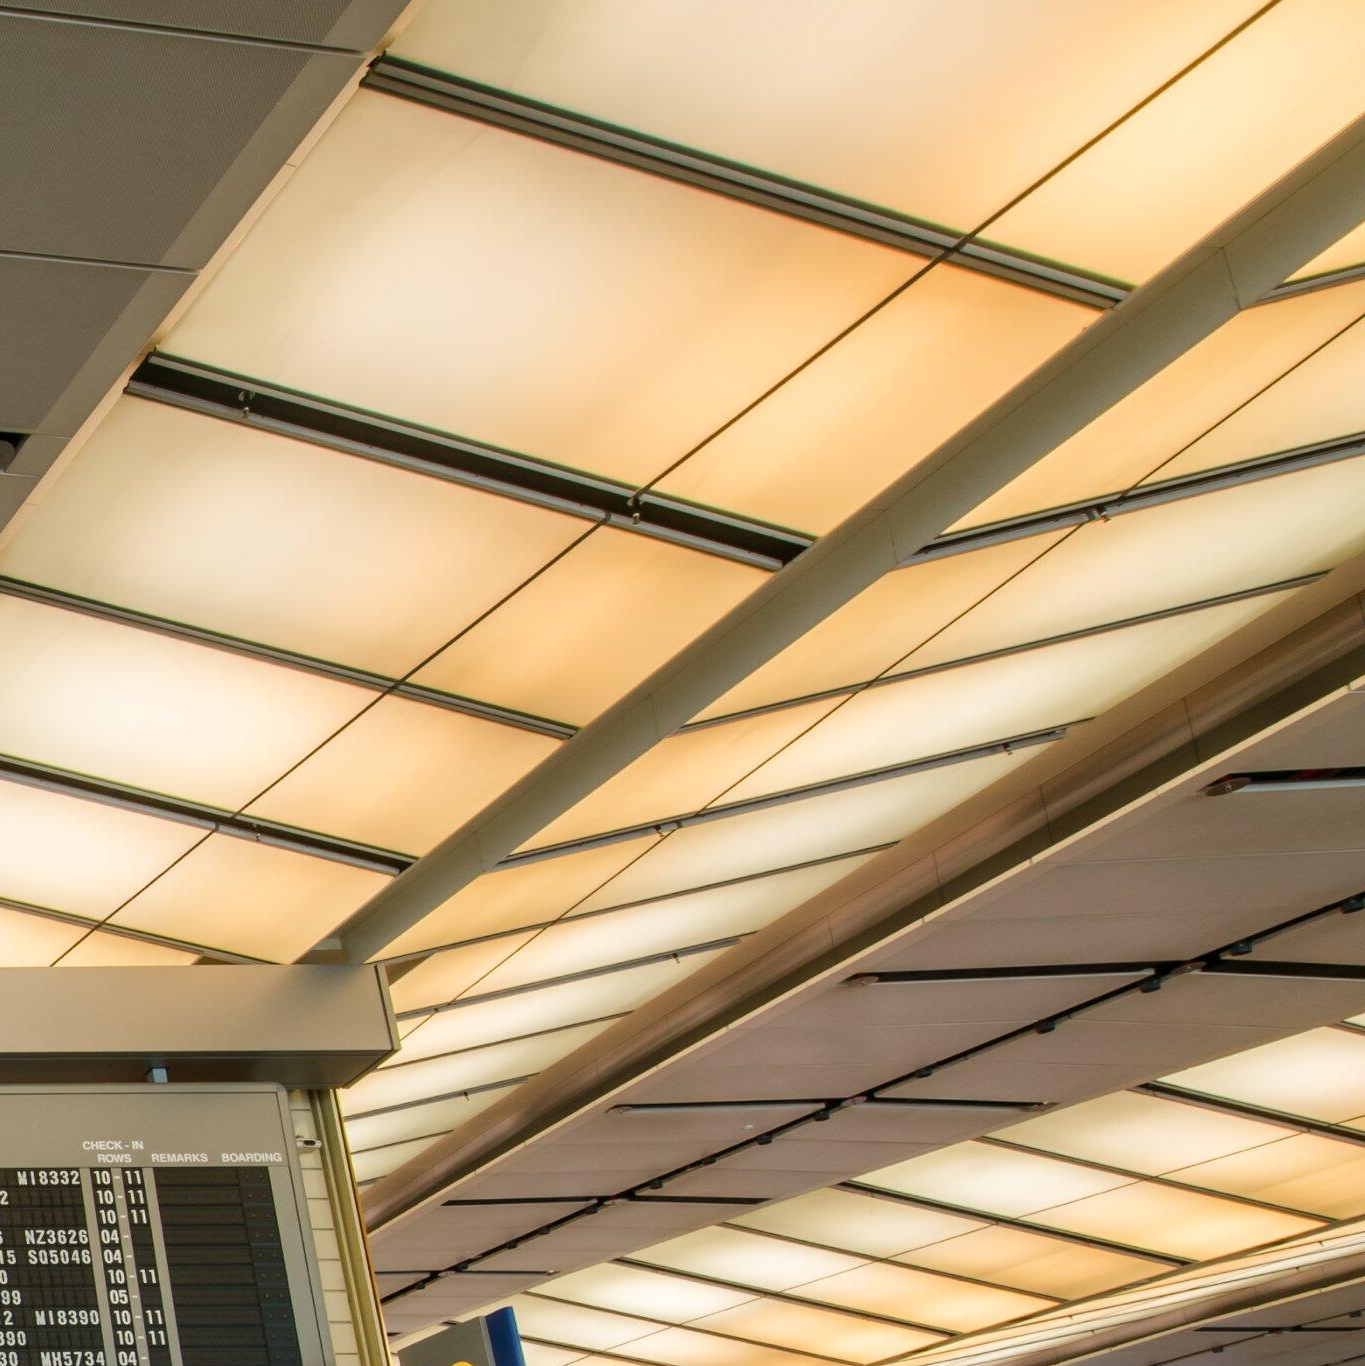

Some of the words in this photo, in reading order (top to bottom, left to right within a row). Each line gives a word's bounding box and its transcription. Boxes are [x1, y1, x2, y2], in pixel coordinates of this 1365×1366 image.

[83, 1141, 120, 1149] CHECK
[133, 1141, 143, 1149] IN
[98, 1154, 132, 1162] ROWS
[152, 1153, 208, 1162] REMARKS
[222, 1153, 282, 1162] BOARDING
